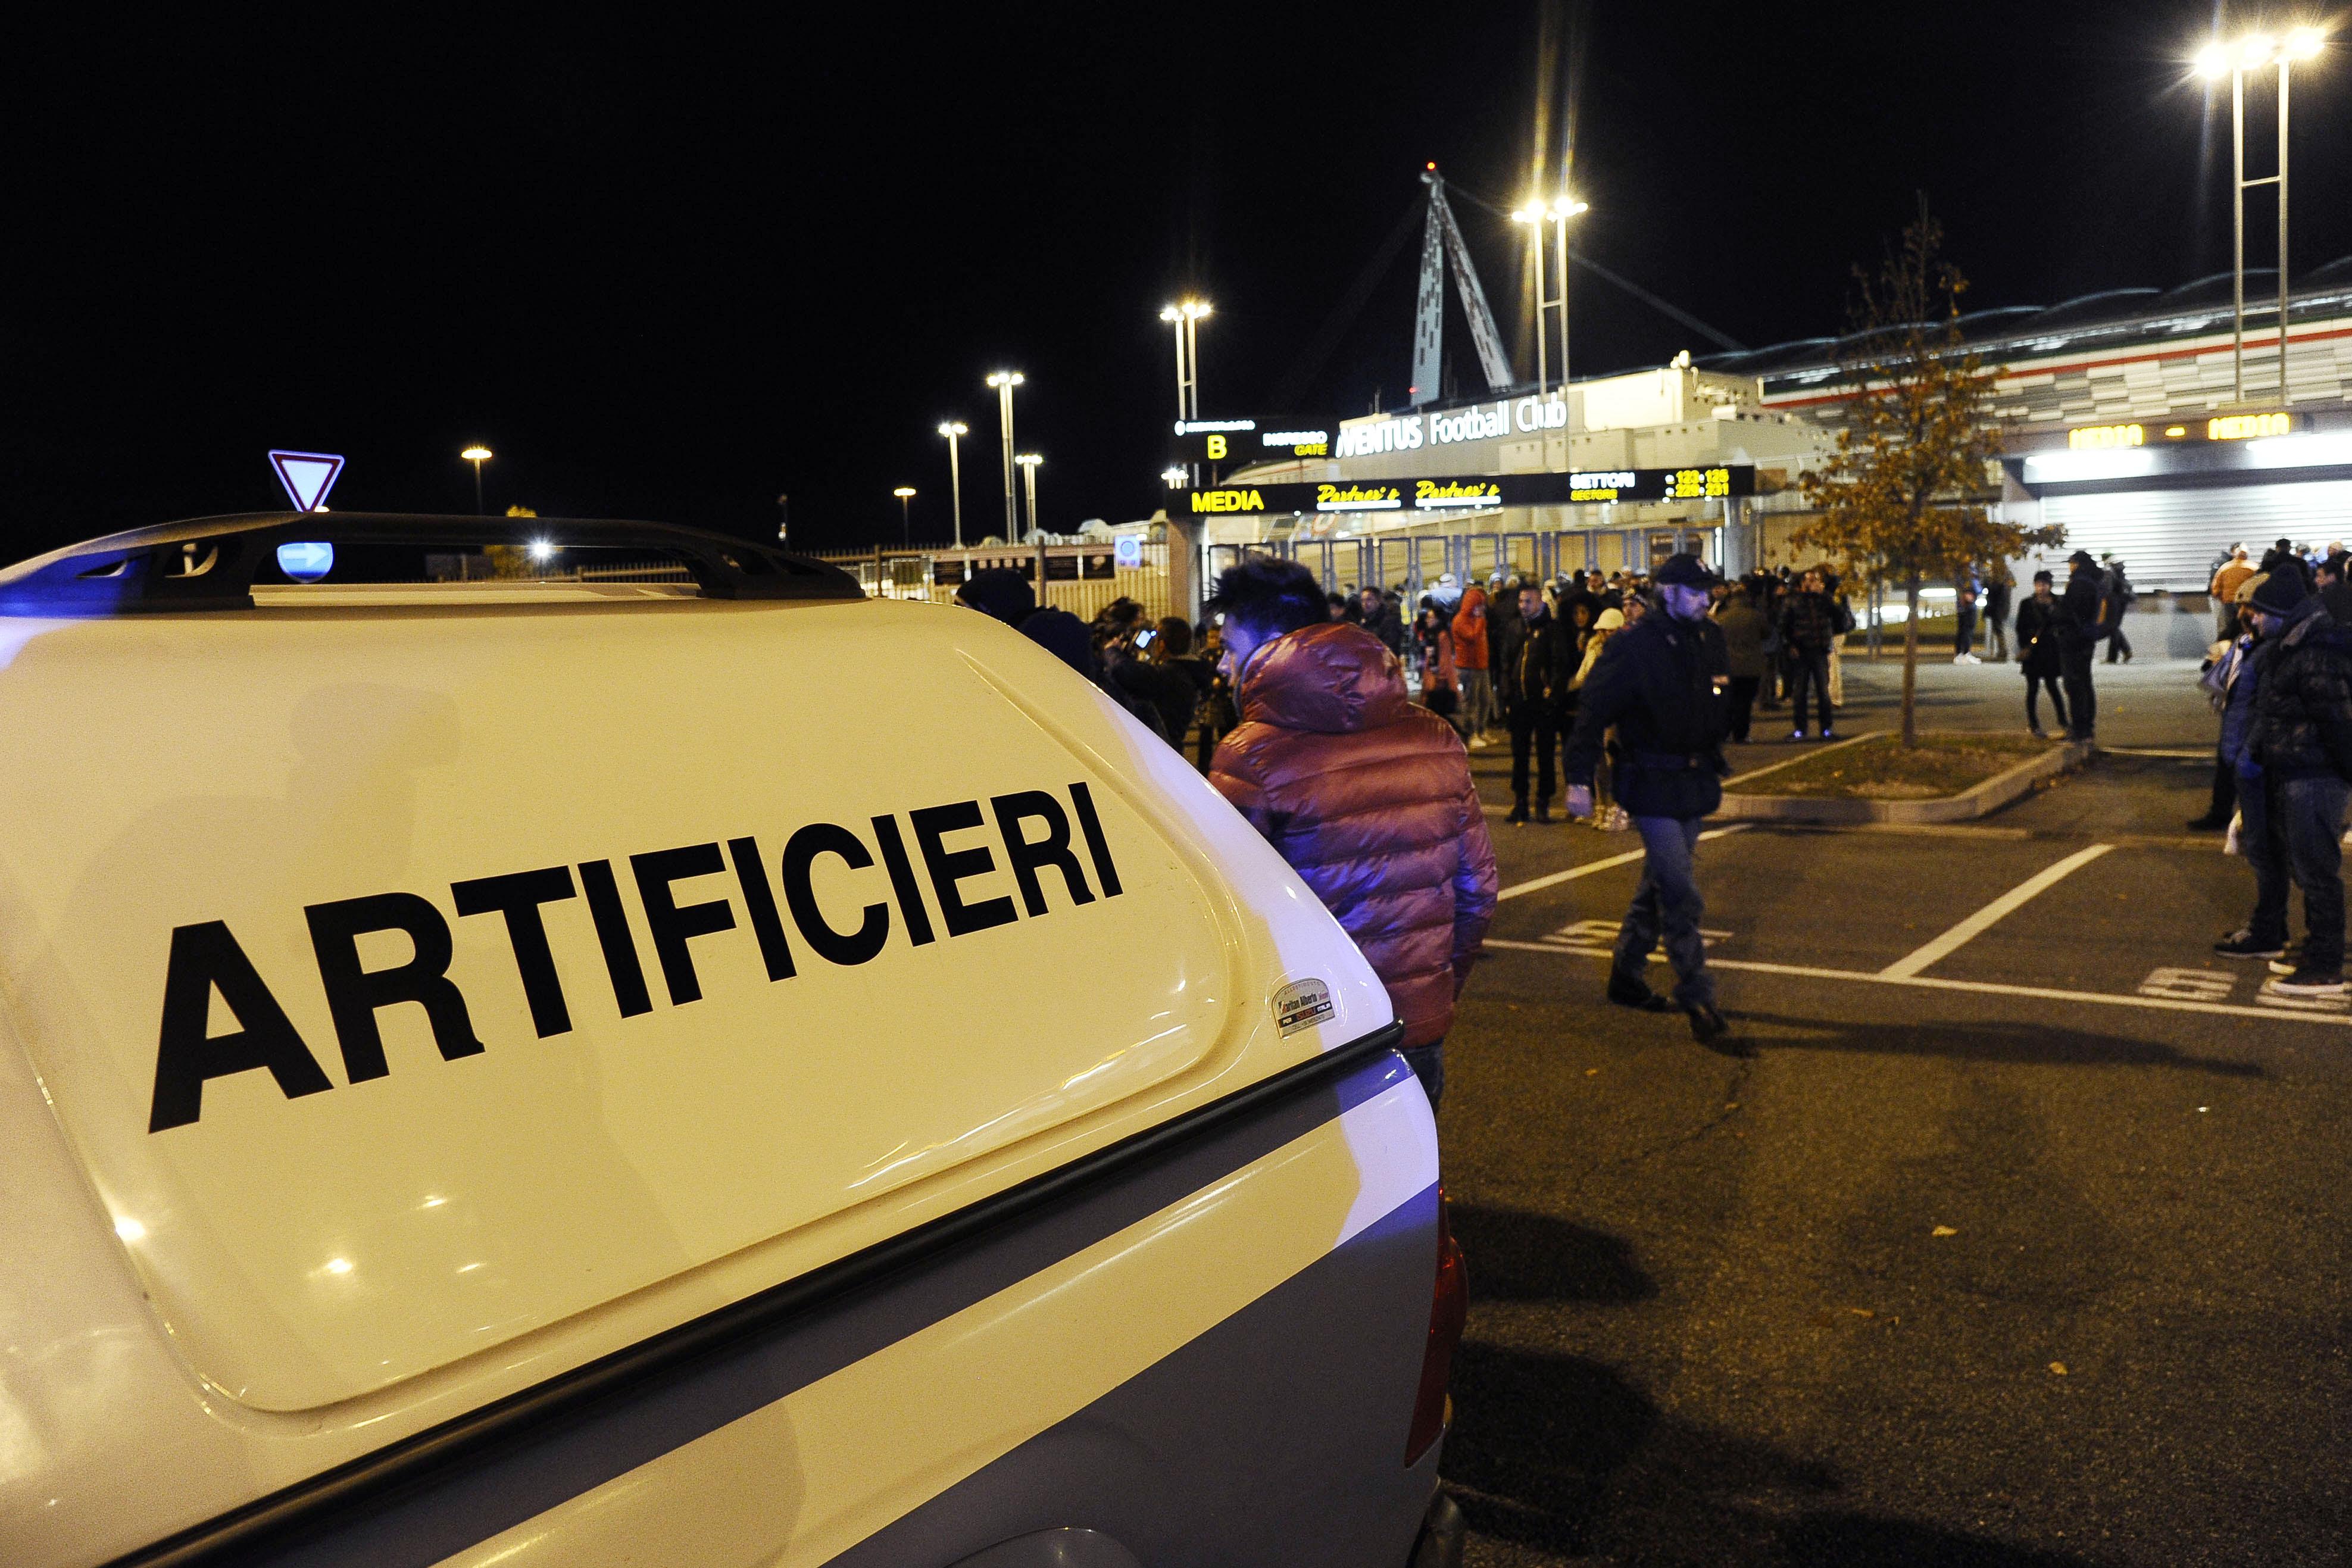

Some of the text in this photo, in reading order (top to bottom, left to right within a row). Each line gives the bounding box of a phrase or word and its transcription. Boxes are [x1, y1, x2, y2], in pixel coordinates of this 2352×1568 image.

[1335, 392, 1567, 458] VENTUS Football Club
[2208, 413, 2289, 440] MEDIA
[1208, 435, 1227, 459] B
[1294, 443, 1328, 456] GATE
[1191, 490, 1264, 512] MEDIA
[1570, 489, 1618, 501] SECTORS
[148, 781, 1124, 1135] ARTIFICIERI
